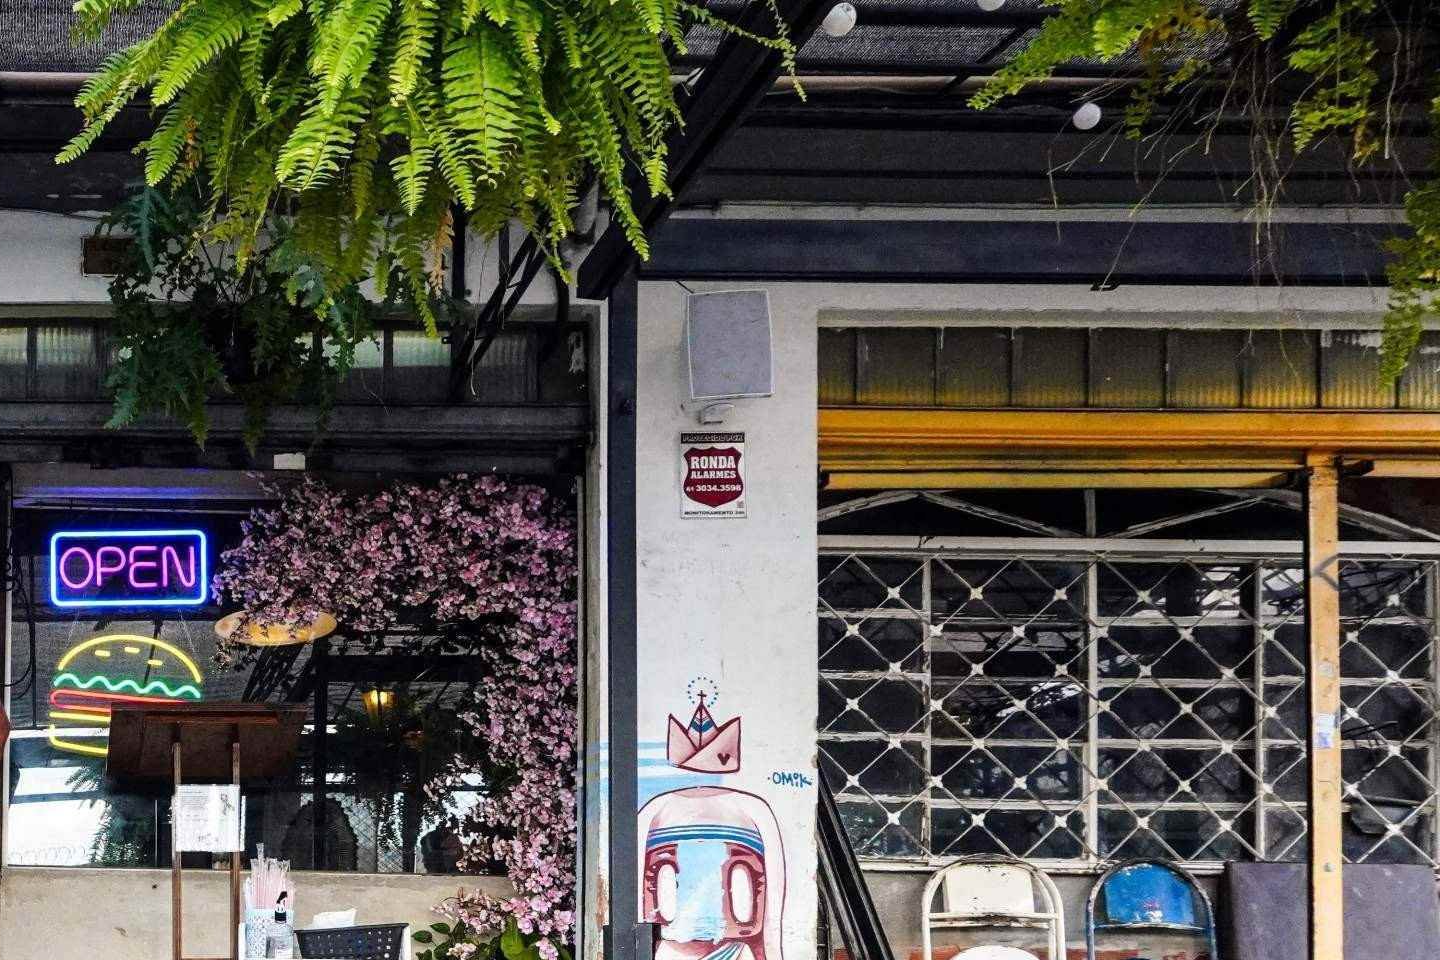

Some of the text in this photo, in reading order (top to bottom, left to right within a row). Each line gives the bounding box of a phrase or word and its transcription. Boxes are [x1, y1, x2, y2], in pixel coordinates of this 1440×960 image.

[690, 455, 736, 469] RONDA
[690, 471, 737, 479] ALARMES
[60, 545, 196, 589] OPEN
